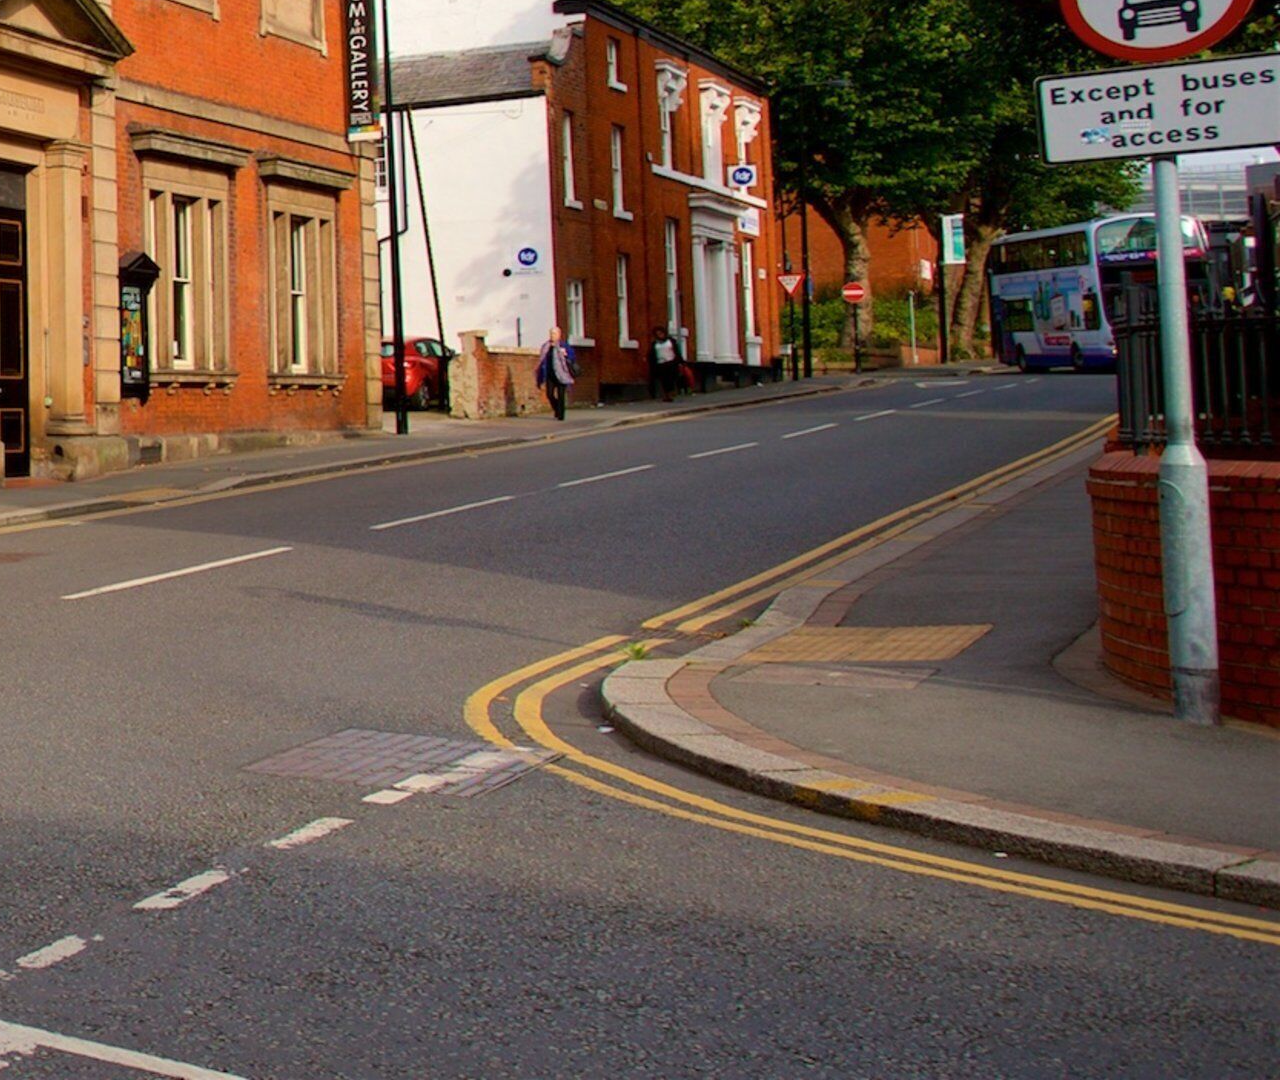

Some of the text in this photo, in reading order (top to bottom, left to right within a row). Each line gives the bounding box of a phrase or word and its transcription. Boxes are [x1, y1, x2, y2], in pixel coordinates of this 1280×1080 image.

[349, 35, 369, 112] GALLERY
[1050, 69, 1276, 106] Except buses
[1100, 103, 1155, 125] and
[1180, 98, 1226, 117] for
[1111, 125, 1220, 149] access
